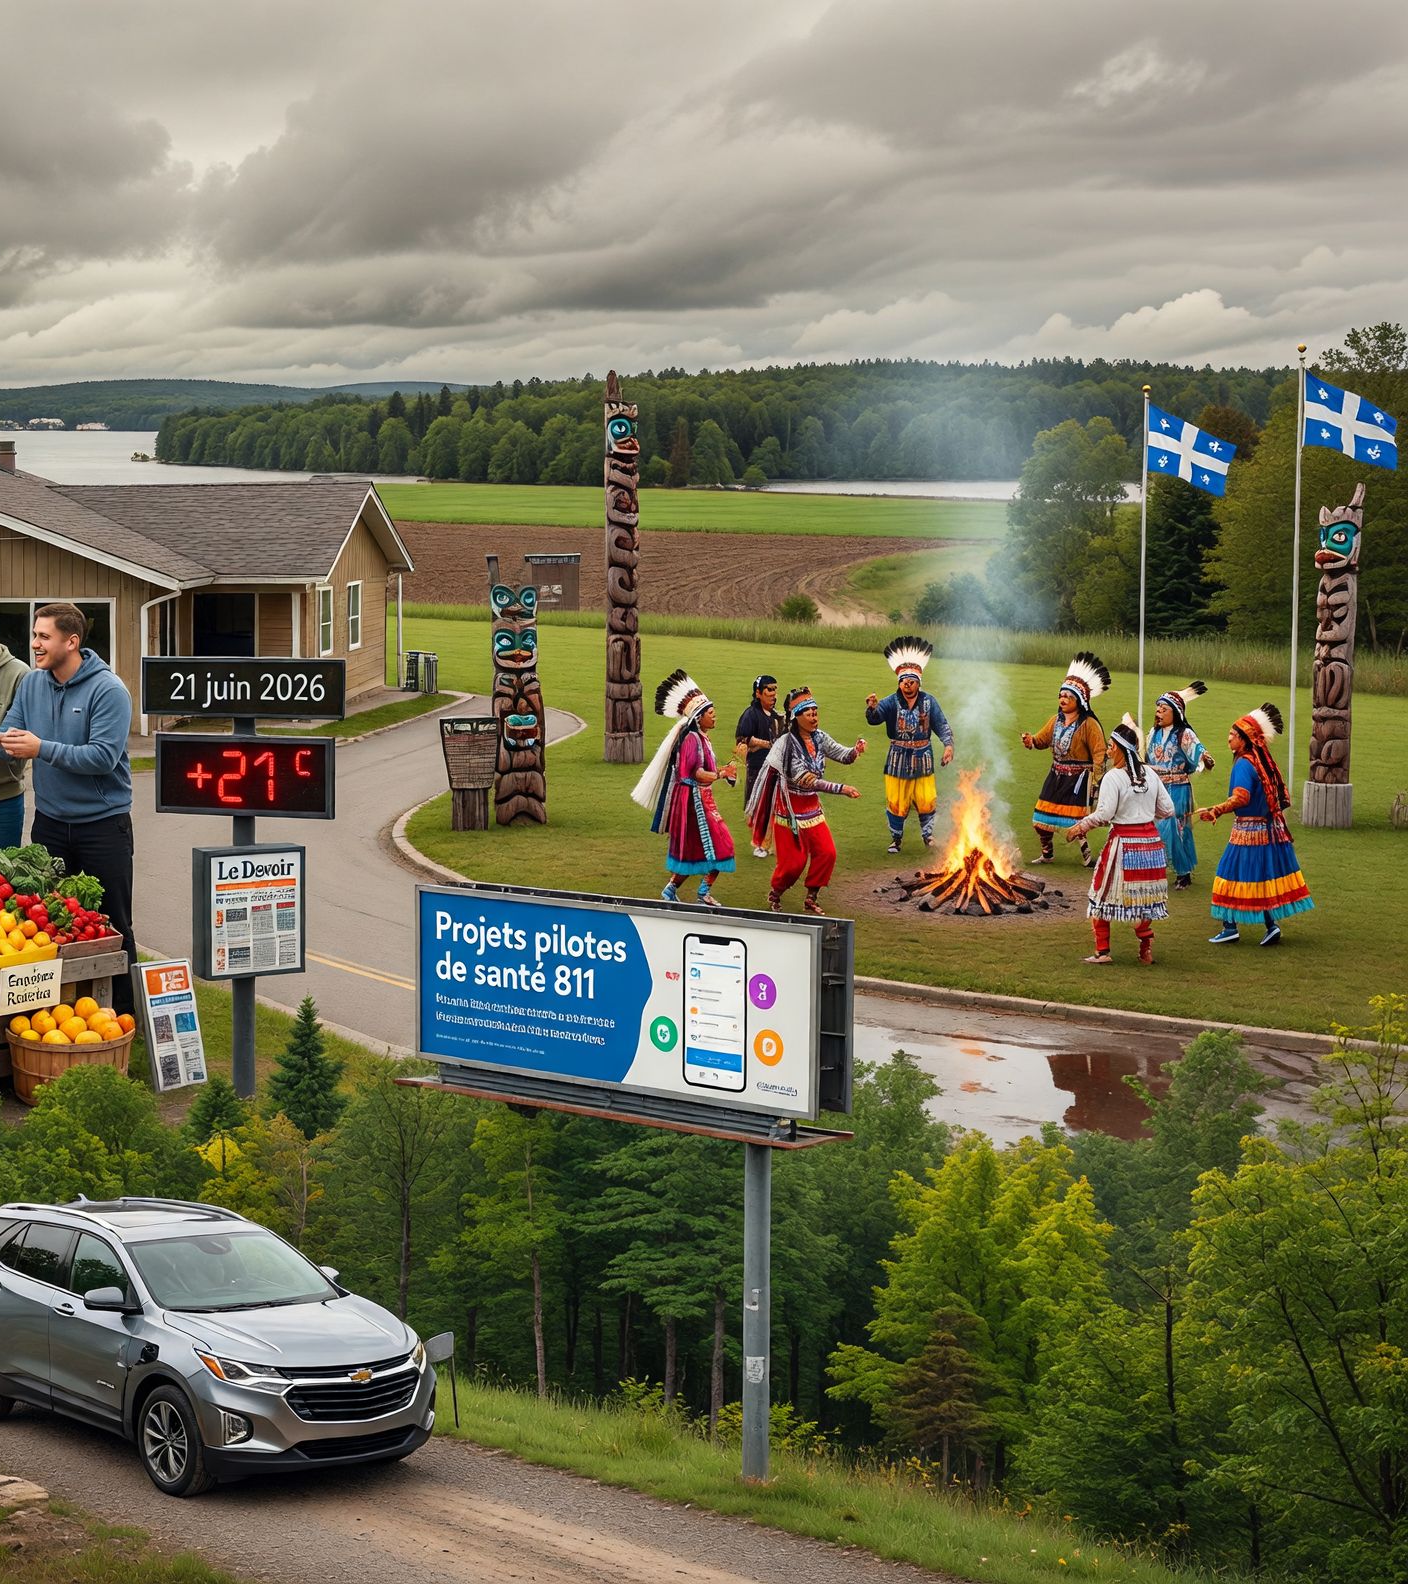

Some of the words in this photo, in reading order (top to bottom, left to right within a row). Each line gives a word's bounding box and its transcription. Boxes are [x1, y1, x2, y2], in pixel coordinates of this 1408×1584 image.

[170, 672, 196, 701] 21
[202, 672, 251, 709] juin
[260, 673, 325, 702] 2026
[217, 861, 239, 880] Le
[435, 911, 526, 956] Projets
[534, 924, 627, 963] pilotes
[435, 951, 467, 983] de
[473, 961, 547, 993] santé
[555, 965, 595, 999] 811
